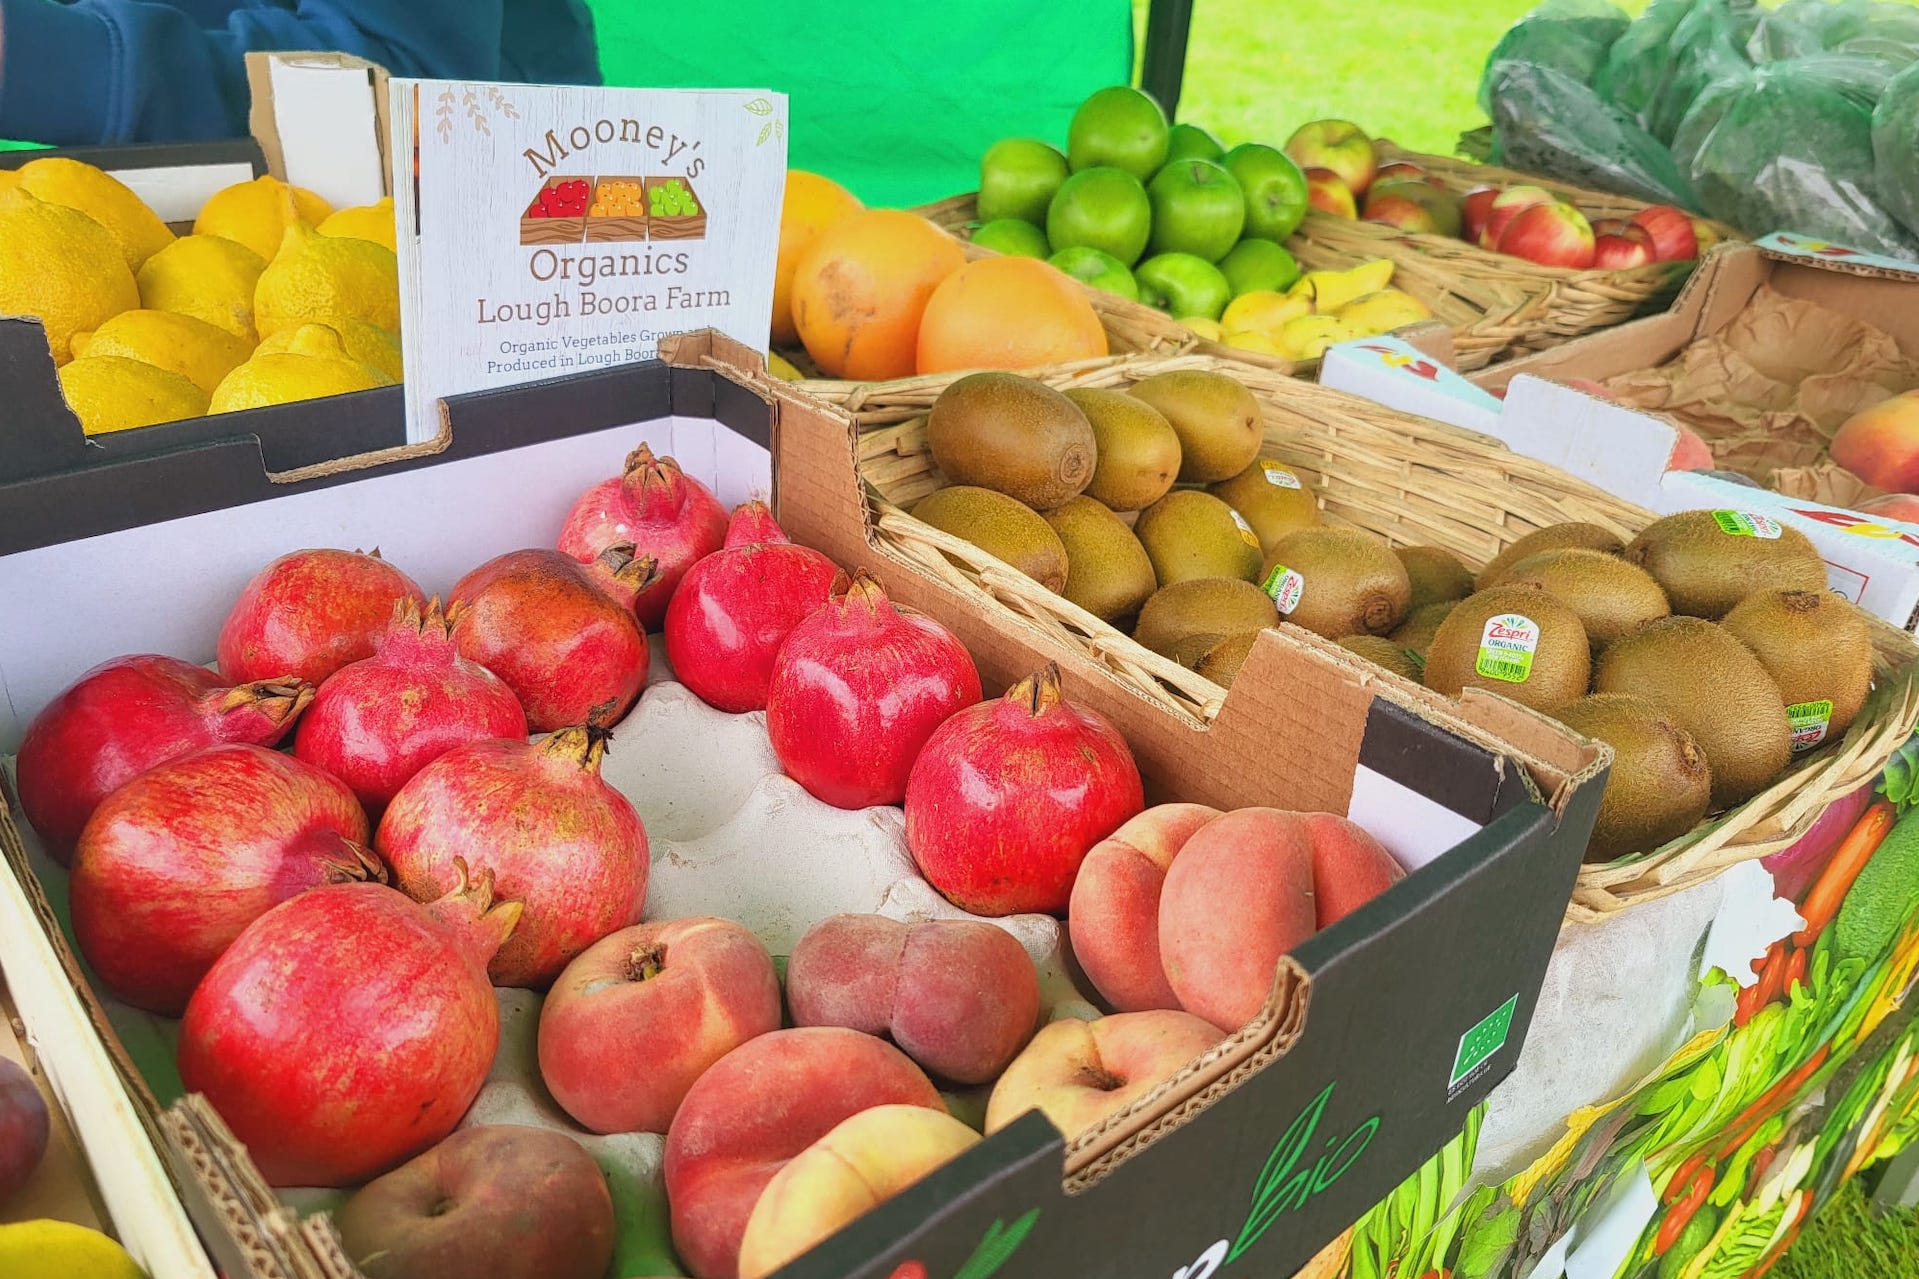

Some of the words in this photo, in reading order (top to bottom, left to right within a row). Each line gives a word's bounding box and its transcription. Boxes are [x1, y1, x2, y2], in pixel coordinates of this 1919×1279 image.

[523, 118, 705, 179] Mooney's
[530, 245, 690, 287] Organics
[477, 293, 571, 326] Lough
[580, 292, 657, 316] Boora
[666, 286, 731, 310] Farm
[500, 337, 558, 355] Organic
[562, 331, 637, 353] Vegetables
[487, 356, 557, 374] Produced
[560, 355, 574, 367] in
[578, 349, 621, 367] Lough
[625, 347, 659, 361] Boor
[1280, 576, 1299, 610] Zespri
[1488, 622, 1532, 641] Zespri
[1488, 638, 1529, 652] ORGANIC
